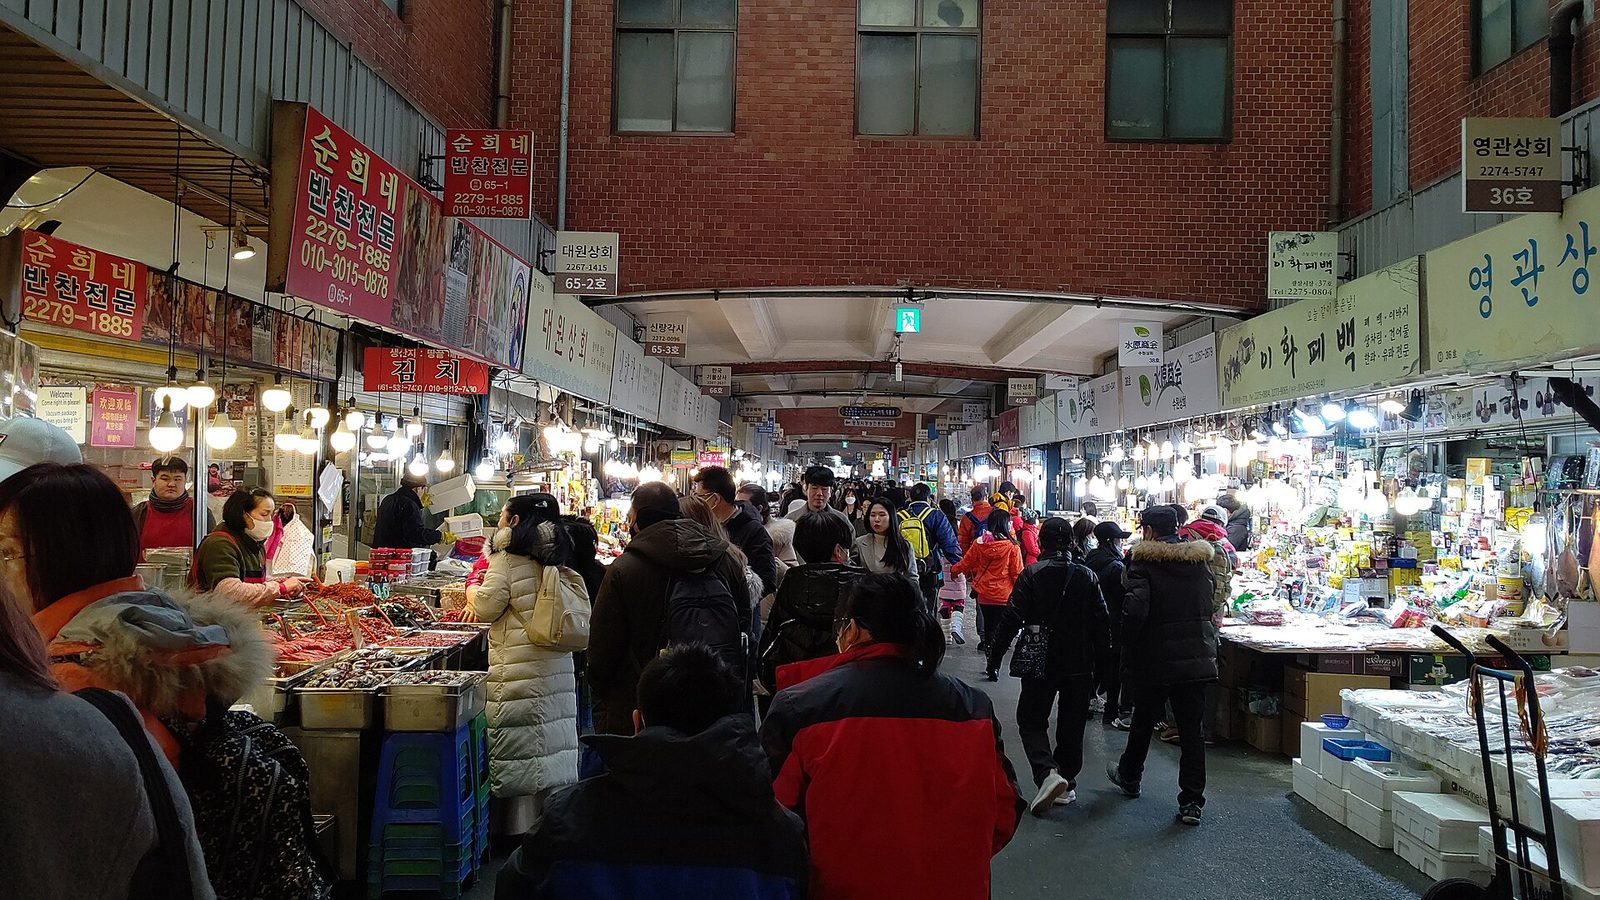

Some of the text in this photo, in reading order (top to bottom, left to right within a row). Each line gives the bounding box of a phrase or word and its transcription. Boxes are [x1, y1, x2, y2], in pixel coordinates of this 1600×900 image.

[452, 133, 529, 155] 순희네
[1473, 137, 1552, 158] 영관상회
[310, 125, 399, 215] 순희네
[452, 157, 529, 177] 반찬전문
[1480, 166, 1544, 177] 2274-5747
[484, 180, 509, 190] 65-1
[454, 193, 523, 205] 2279-1885
[1489, 187, 1535, 205] 36호
[307, 169, 395, 251] 반찬전문
[452, 205, 524, 217] 010-3015-0878
[305, 215, 391, 273] 2279-1885
[562, 245, 613, 259] 대원상회
[26, 236, 136, 290] 순희네
[301, 239, 389, 299] 010-3015-0878
[566, 263, 608, 272] 2267-1415
[1273, 256, 1333, 274] 이화폐백
[24, 263, 137, 317] 반찬전문
[565, 276, 607, 291] 65-2호
[335, 288, 352, 307] 65-1
[24, 295, 134, 338] 2279-1885
[541, 308, 588, 368] 대원상회
[390, 349, 416, 358] 생산지
[651, 345, 680, 355] 65-3호
[1260, 317, 1356, 379] 이화폐백
[391, 358, 460, 386] 김치
[50, 390, 72, 398] Welcome
